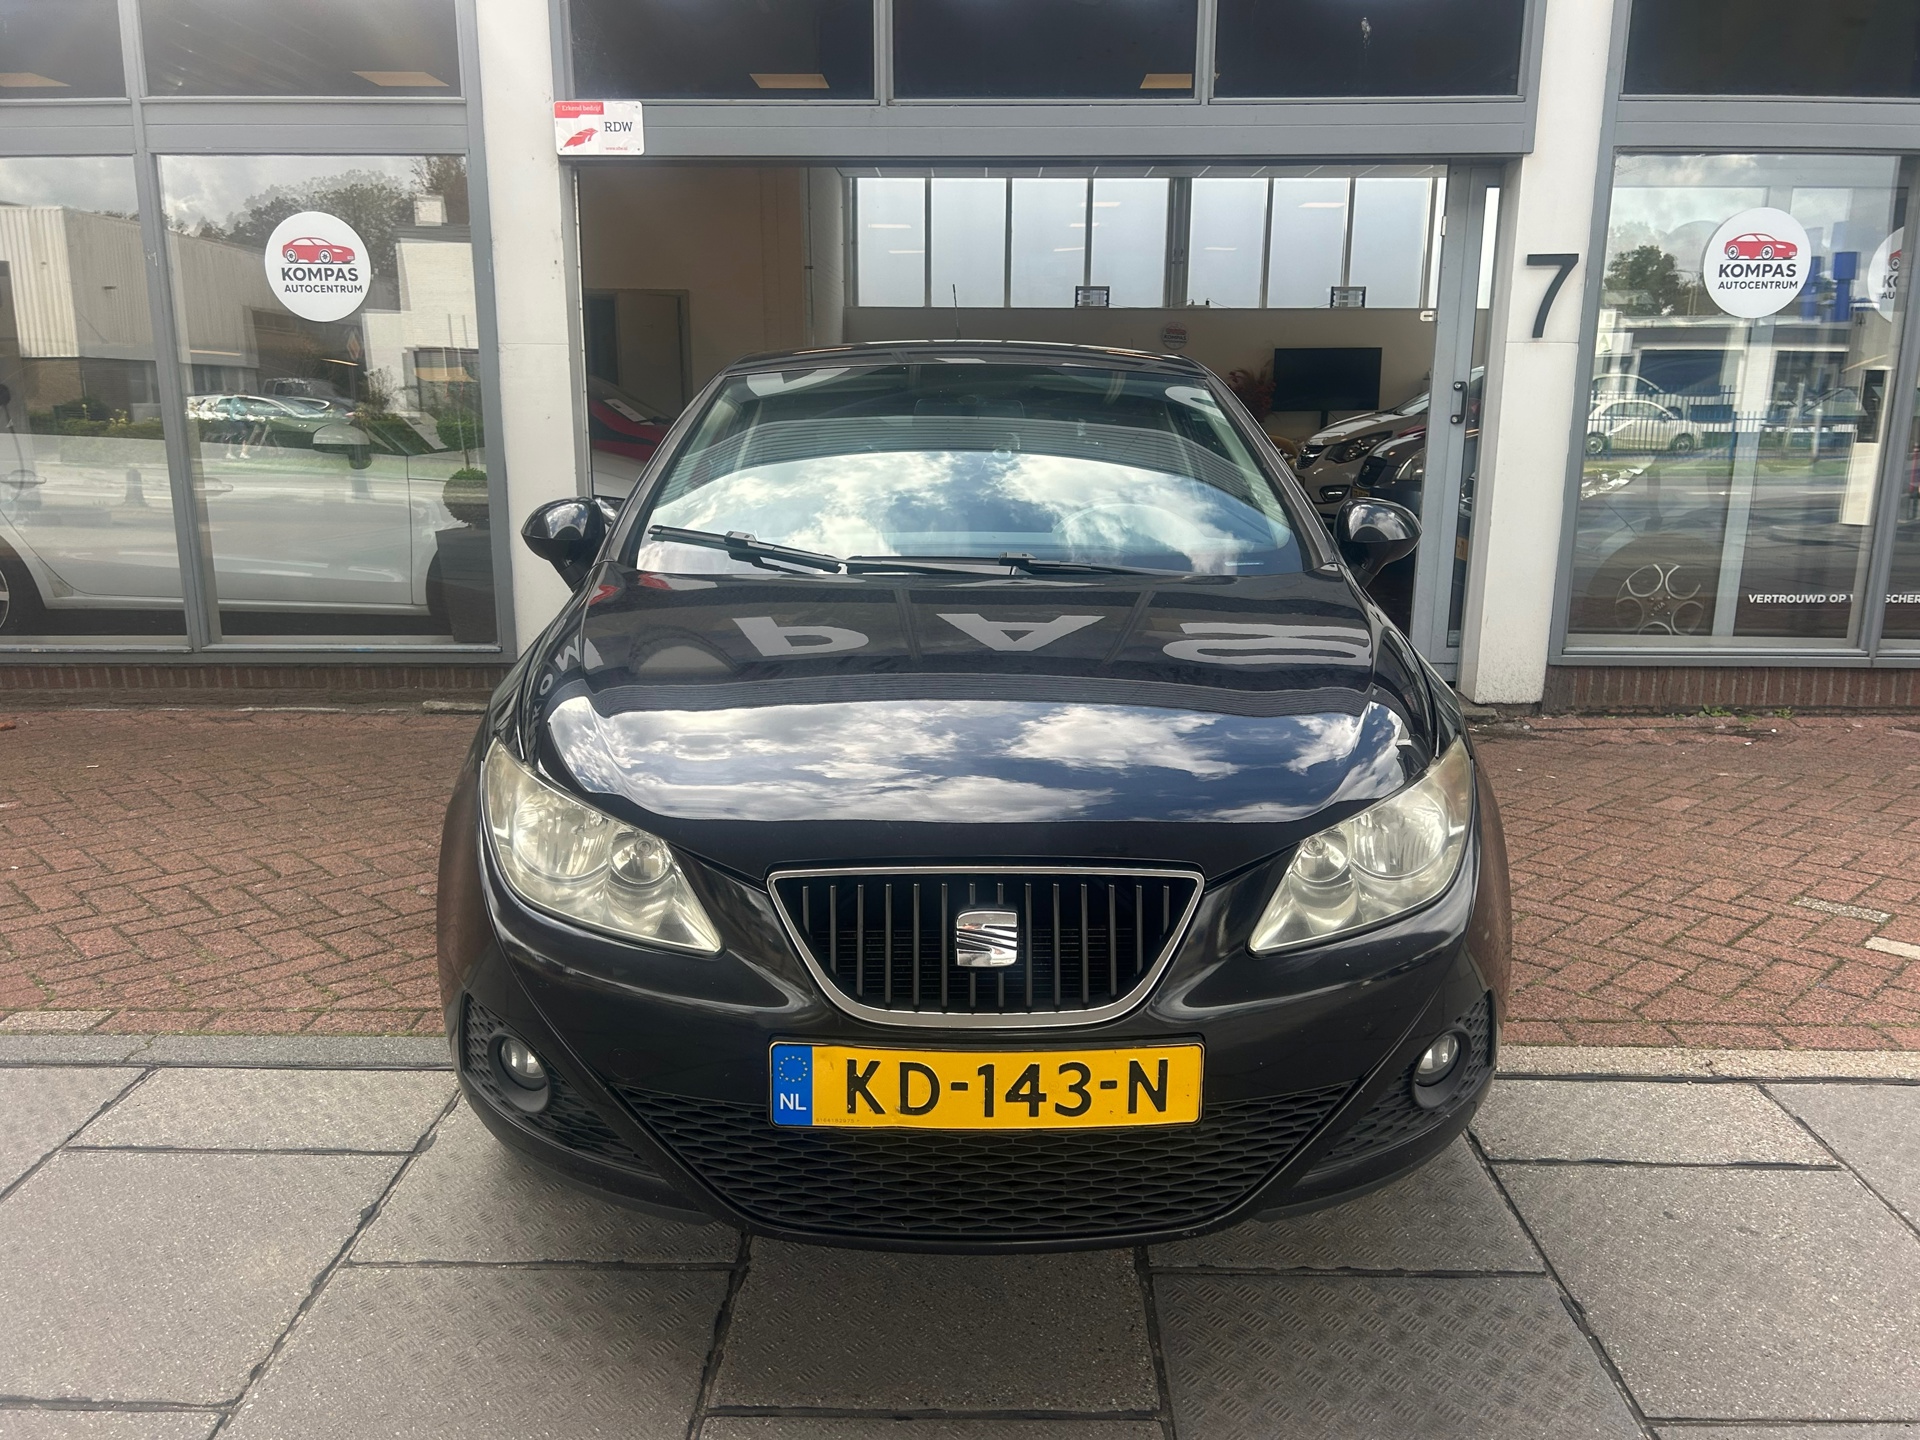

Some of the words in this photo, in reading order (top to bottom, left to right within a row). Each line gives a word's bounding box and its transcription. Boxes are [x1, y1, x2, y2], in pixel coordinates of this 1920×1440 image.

[604, 121, 633, 133] RDW
[281, 267, 359, 282] KOMPAS
[1718, 263, 1797, 278] KOMPAS
[284, 284, 363, 294] AUTOCENTRUM
[1717, 280, 1798, 290] AUTOCENTRUM
[1526, 253, 1580, 339] 7
[1748, 594, 1826, 604] VERTROUWD
[1829, 594, 1847, 604] OP
[846, 1058, 1169, 1119] KD-143-N
[779, 1092, 807, 1111] NL
